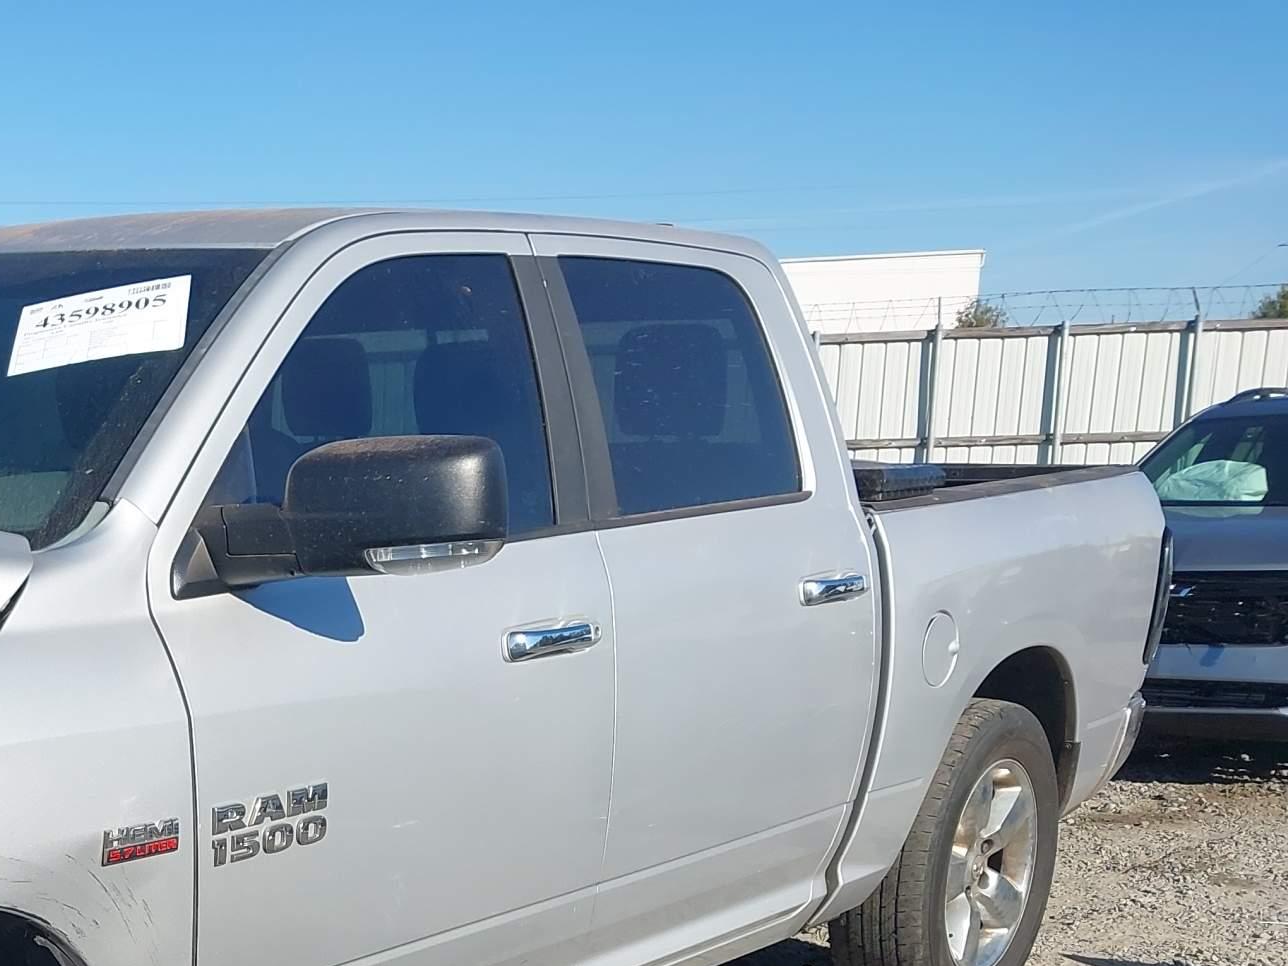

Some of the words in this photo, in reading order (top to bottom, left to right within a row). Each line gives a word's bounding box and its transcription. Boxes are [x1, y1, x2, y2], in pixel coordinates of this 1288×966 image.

[35, 293, 168, 329] 43598905
[211, 781, 329, 836] RAM
[103, 817, 180, 849] HEMI
[108, 846, 135, 862] 5.7
[136, 838, 177, 857] LITER
[211, 814, 329, 867] 1500
